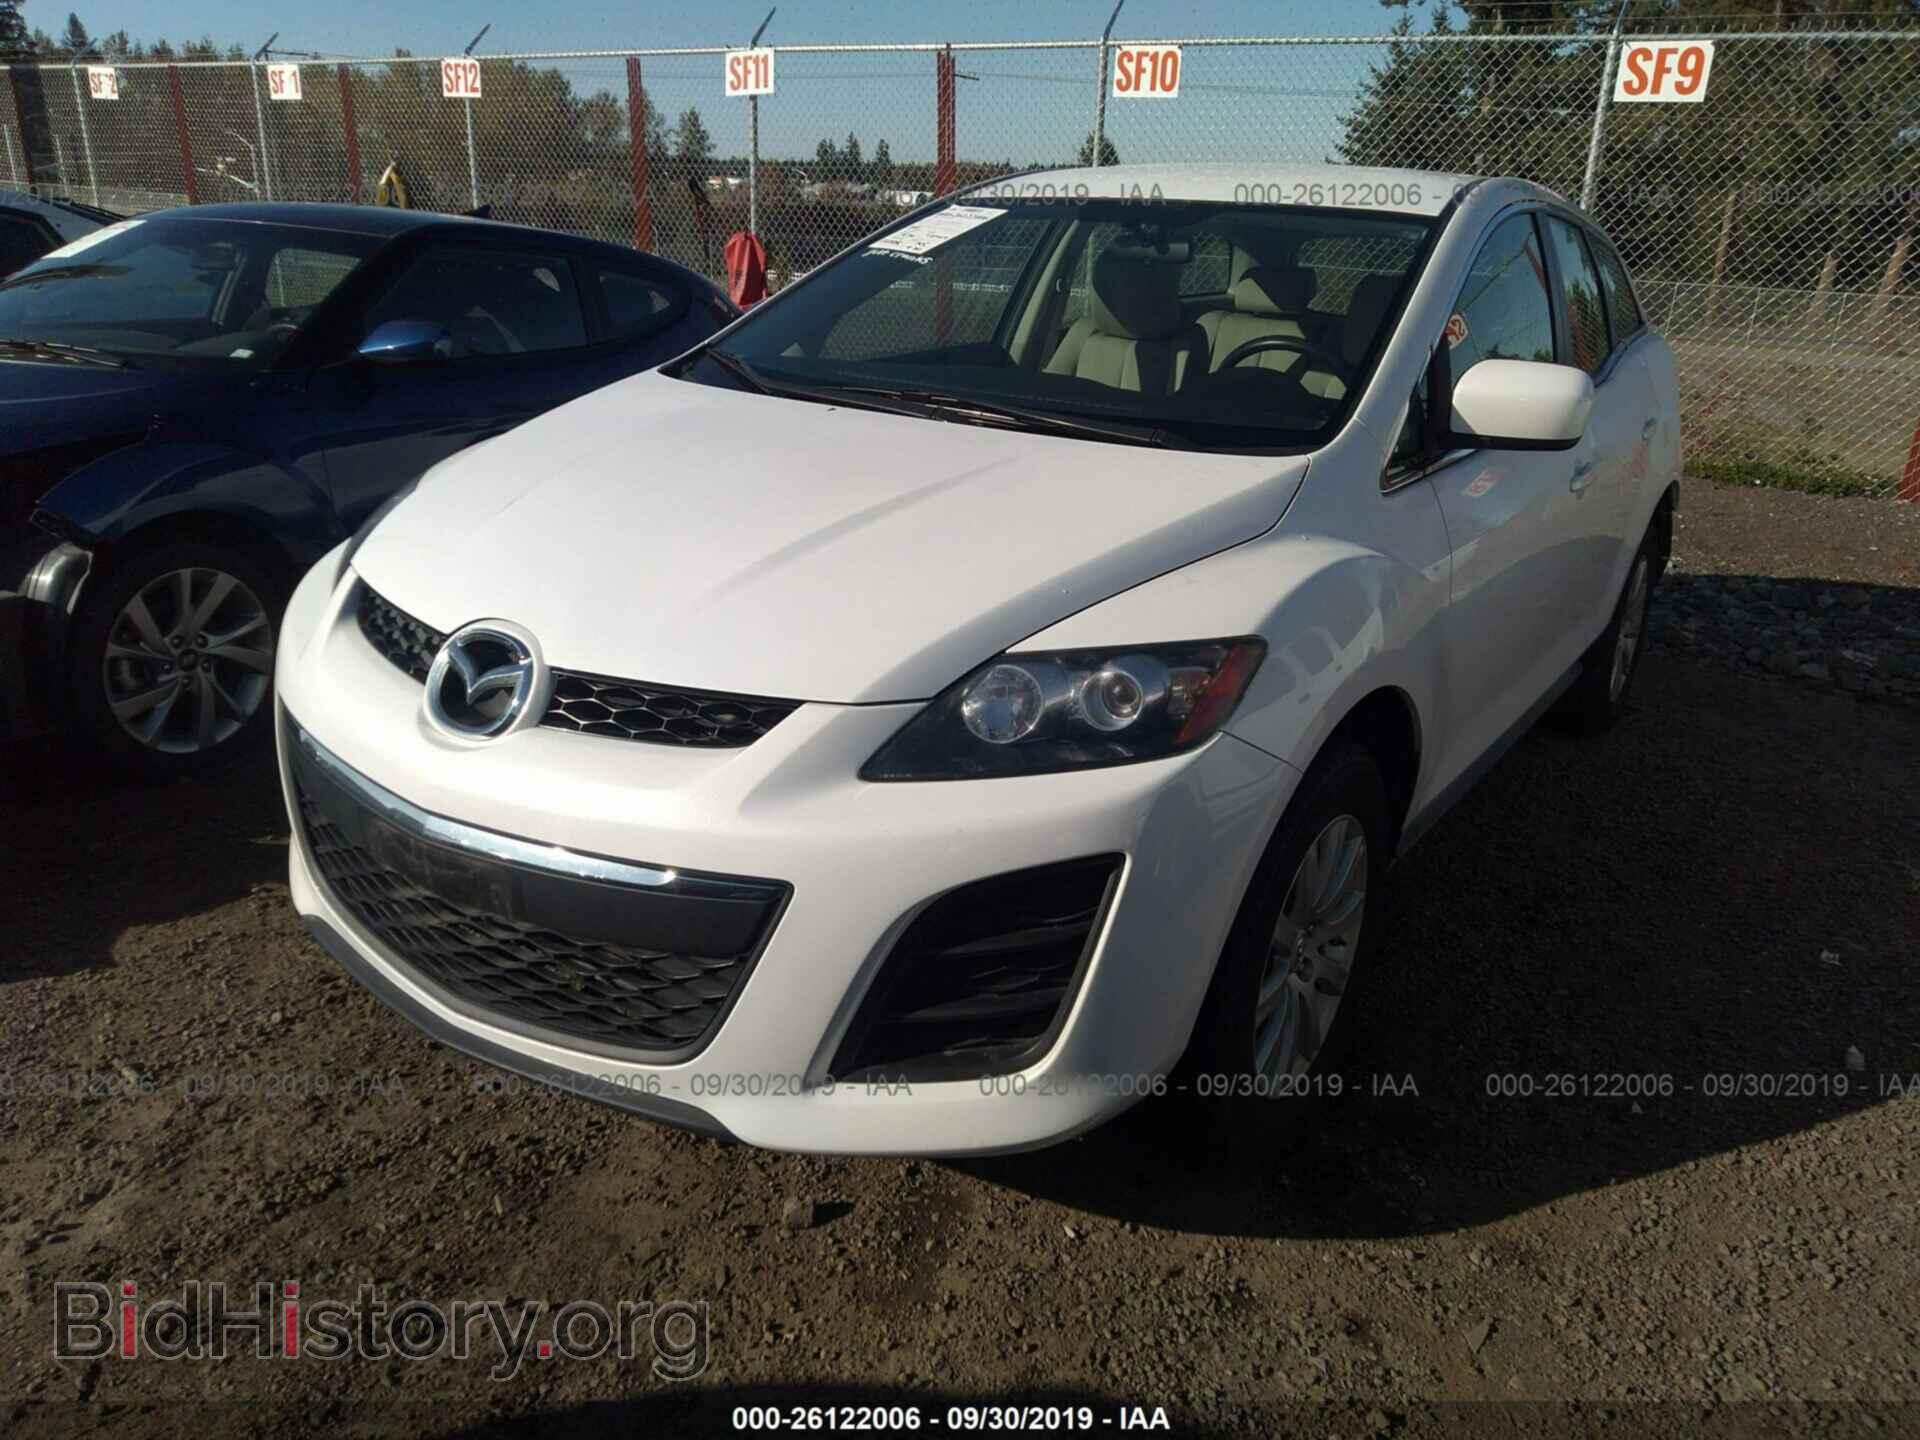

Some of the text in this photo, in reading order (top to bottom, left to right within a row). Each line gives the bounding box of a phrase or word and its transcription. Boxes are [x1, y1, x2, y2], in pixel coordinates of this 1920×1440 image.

[444, 62, 479, 92] SF12
[730, 54, 769, 90] SF11
[1116, 50, 1179, 92] SF10
[1623, 47, 1705, 96] SF9
